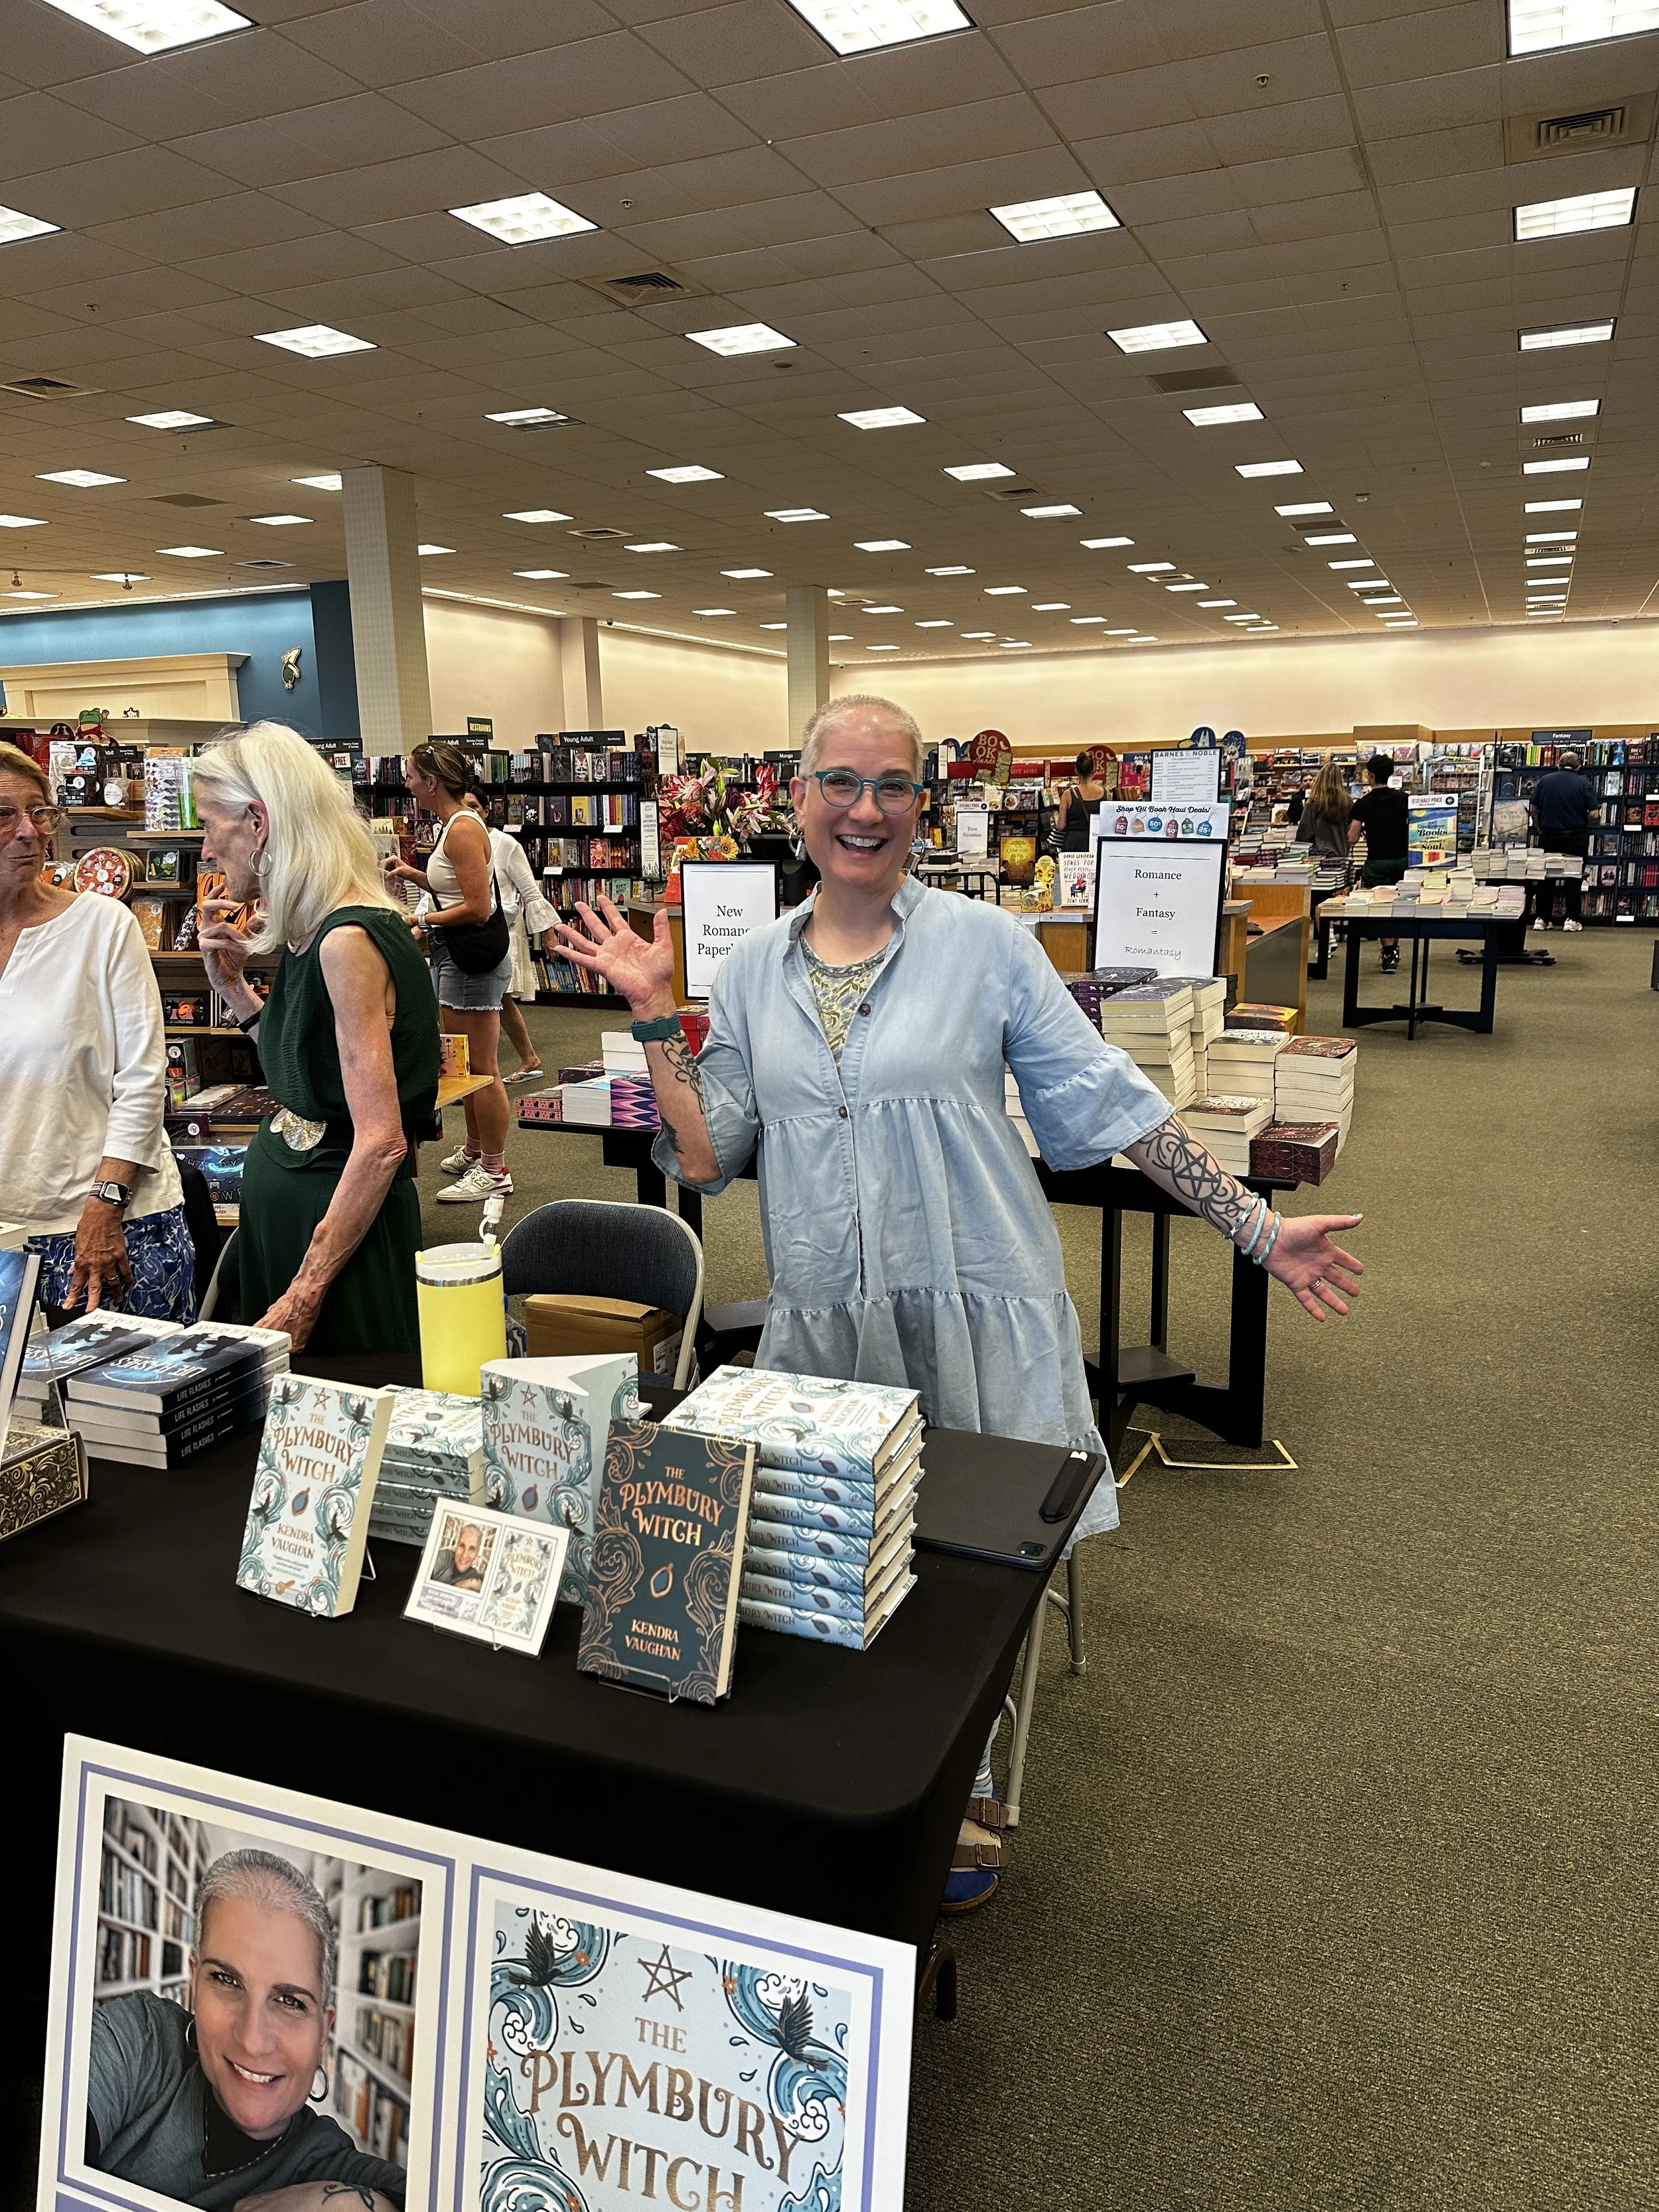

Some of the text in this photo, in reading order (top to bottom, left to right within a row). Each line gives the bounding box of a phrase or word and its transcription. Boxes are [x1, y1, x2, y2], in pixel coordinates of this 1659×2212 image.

[469, 723, 491, 733] RESTROOMS
[335, 757, 347, 766] FREE
[1135, 869, 1182, 879] Romance
[717, 905, 743, 917] New
[1136, 907, 1176, 920] Fantasy
[703, 924, 751, 936] Roman
[697, 943, 733, 958] Paper
[1125, 946, 1181, 960] Romantasy
[109, 1356, 207, 1378] LIFE FLASHES
[177, 1390, 188, 1402] LIFE
[189, 1378, 211, 1394] FLASHES
[175, 1410, 186, 1422] LIFE
[186, 1398, 209, 1415] FLASHES
[718, 1377, 778, 1428] PLYMBURY
[743, 1386, 790, 1420] WITCH
[310, 1413, 326, 1425] THE
[521, 1410, 538, 1423] THE
[181, 1428, 192, 1439] LIFE
[192, 1416, 214, 1433] FLASHES
[181, 1445, 192, 1457] LIFE
[193, 1433, 214, 1449] FLASHES
[273, 1426, 356, 1466] PLYMBURY
[490, 1423, 572, 1464] PLYMBURY
[281, 1449, 336, 1483] WITCH
[502, 1445, 557, 1481] WITCH
[770, 1452, 803, 1467] WITCH
[664, 1465, 685, 1481] THE
[773, 1479, 805, 1494] WITCH
[619, 1481, 725, 1526] PLYMBURY
[772, 1506, 804, 1520] WITCH
[277, 1523, 315, 1544] KENDRA
[632, 1507, 702, 1546] WITCH
[272, 1536, 315, 1559] VAUGHAN
[767, 1532, 799, 1547] WITCH
[504, 1552, 543, 1570] PLYMBURY
[764, 1562, 796, 1577] WITCH
[764, 1585, 796, 1599] WITCH
[764, 1610, 795, 1625] WITCH
[631, 1619, 679, 1643] KENDRA
[625, 1635, 681, 1661] VAUGHAN
[634, 2017, 687, 2054] THE
[520, 2049, 805, 2185] PLYMBURY
[557, 2112, 746, 2212] WITCH
